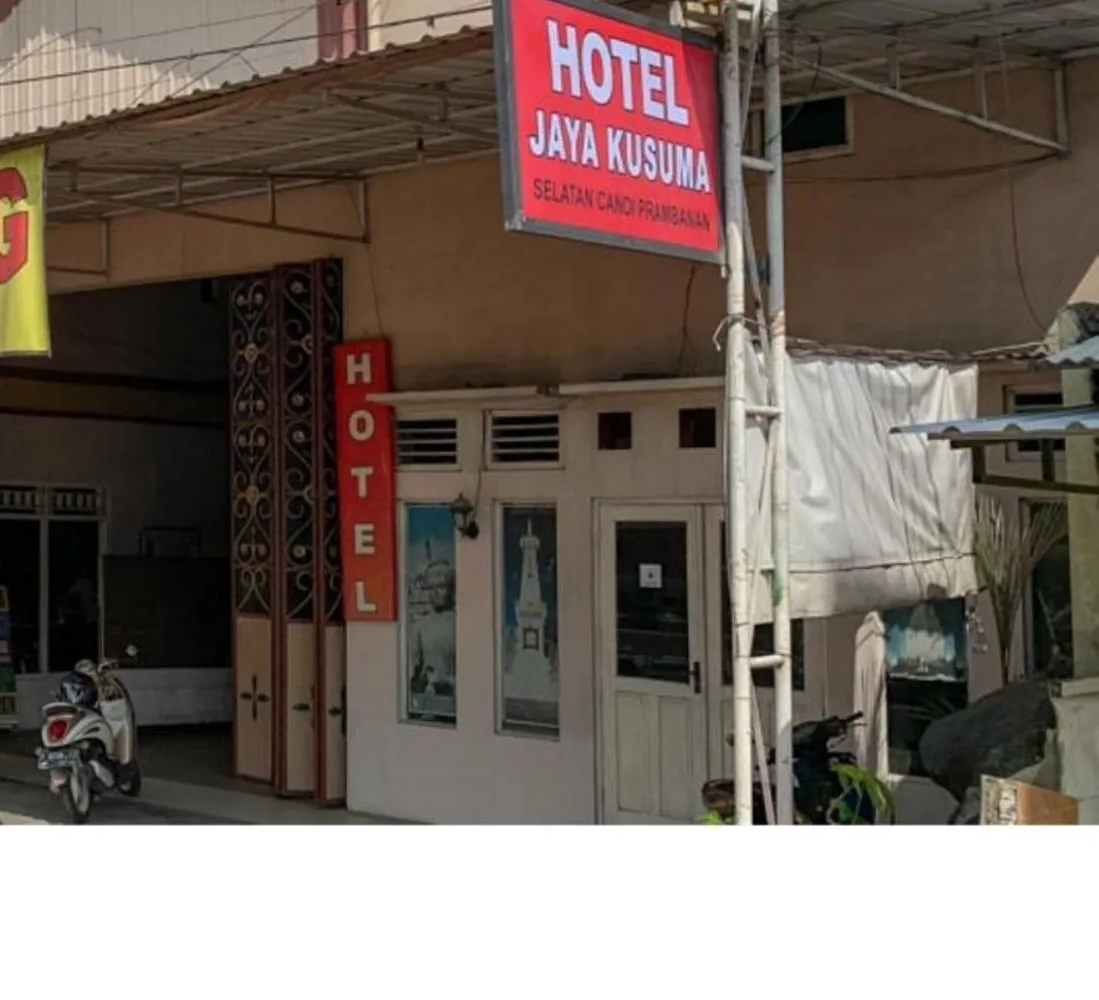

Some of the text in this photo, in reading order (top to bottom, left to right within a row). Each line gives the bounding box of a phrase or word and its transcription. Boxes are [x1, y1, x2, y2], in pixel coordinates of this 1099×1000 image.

[546, 18, 690, 126] HOTEL
[528, 108, 711, 192] JAYA KUSUMA
[533, 178, 711, 232] SELATAN CANDI PRAMBANAN
[346, 352, 377, 613] HOTEL
